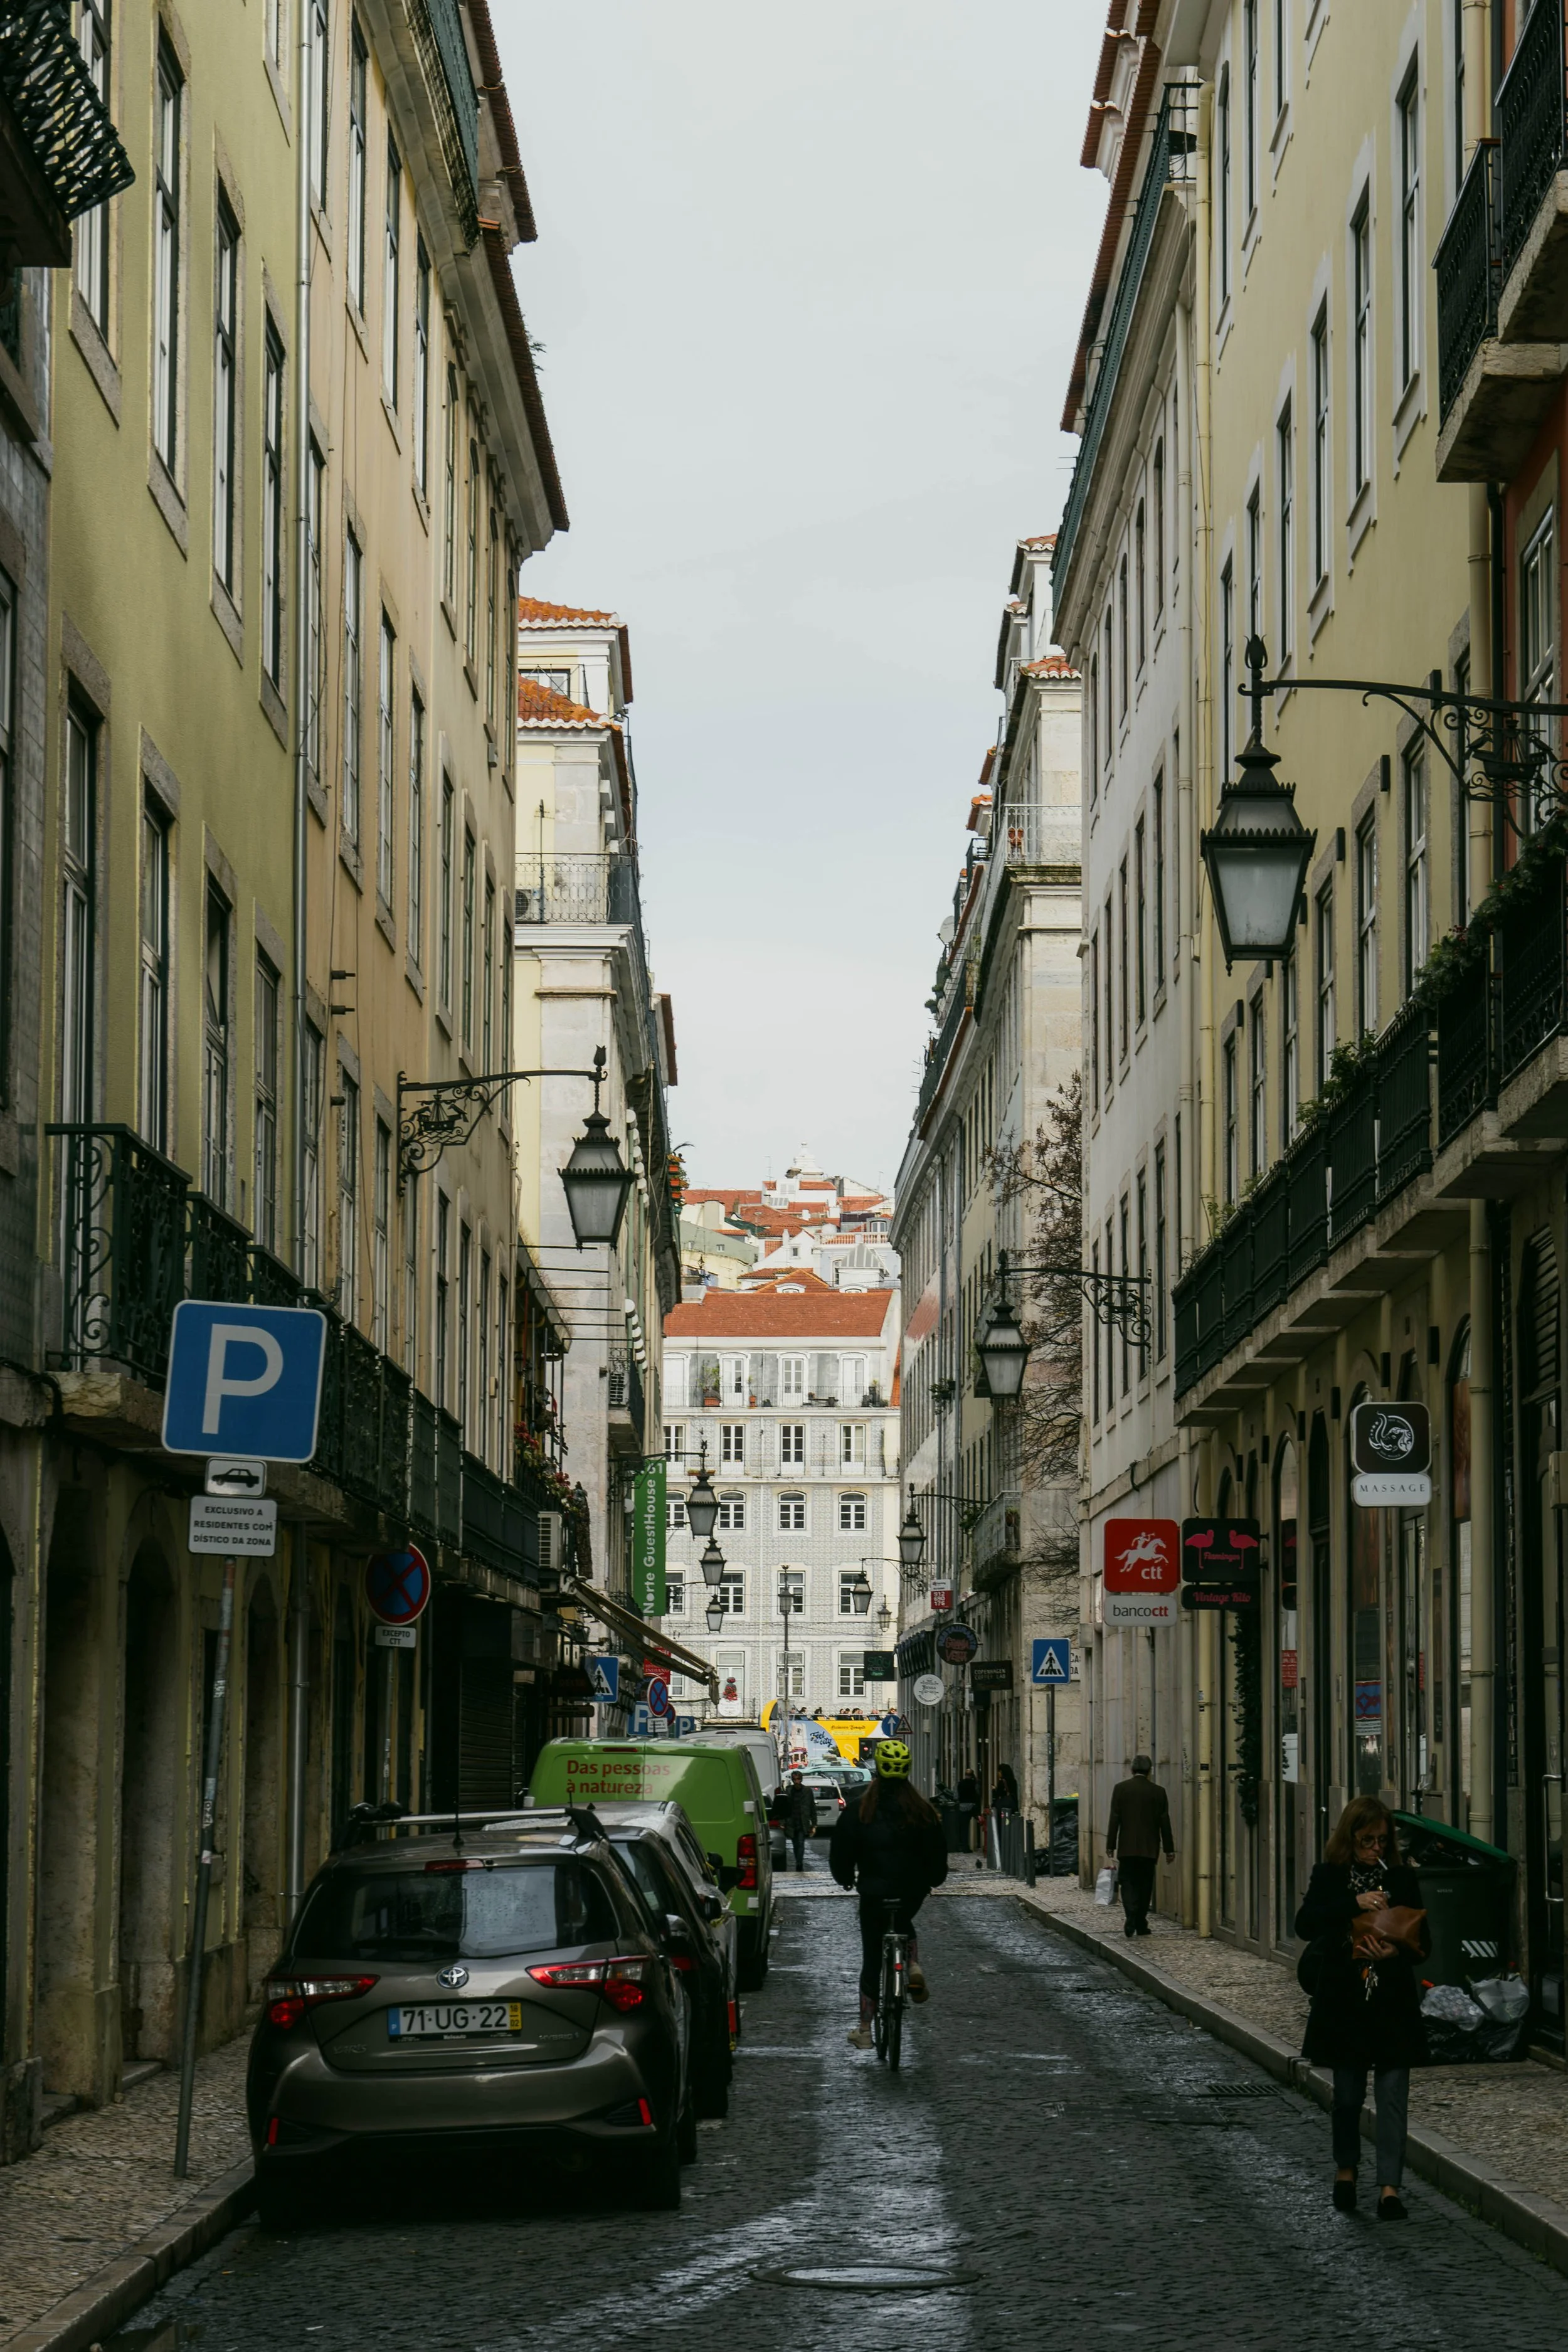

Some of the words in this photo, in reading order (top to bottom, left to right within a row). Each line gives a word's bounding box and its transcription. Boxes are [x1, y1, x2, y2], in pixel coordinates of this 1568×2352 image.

[202, 1323, 284, 1434] P
[1360, 1484, 1426, 1492] MASSAGE
[205, 1506, 254, 1515] EXCLUSIVO
[194, 1520, 250, 1530] RESIDENTES
[252, 1523, 273, 1531] COM
[643, 1479, 656, 1567] GuestHouse
[193, 1534, 229, 1544] DÍSTICO
[1141, 1565, 1163, 1580] ctt
[643, 1572, 655, 1614] Norte
[1193, 1591, 1229, 1605] Vintage
[1231, 1591, 1251, 1602] Kilo
[1113, 1604, 1168, 1616] bancoctt
[383, 1629, 411, 1638] EXCEPTO
[633, 1705, 654, 1732] P
[679, 1717, 691, 1737] P
[810, 1731, 825, 1741] Feel
[819, 1737, 832, 1747] city
[568, 1760, 598, 1774] Das
[602, 1764, 670, 1777] pessoas
[566, 1779, 576, 1793] à
[580, 1781, 652, 1794] natureza
